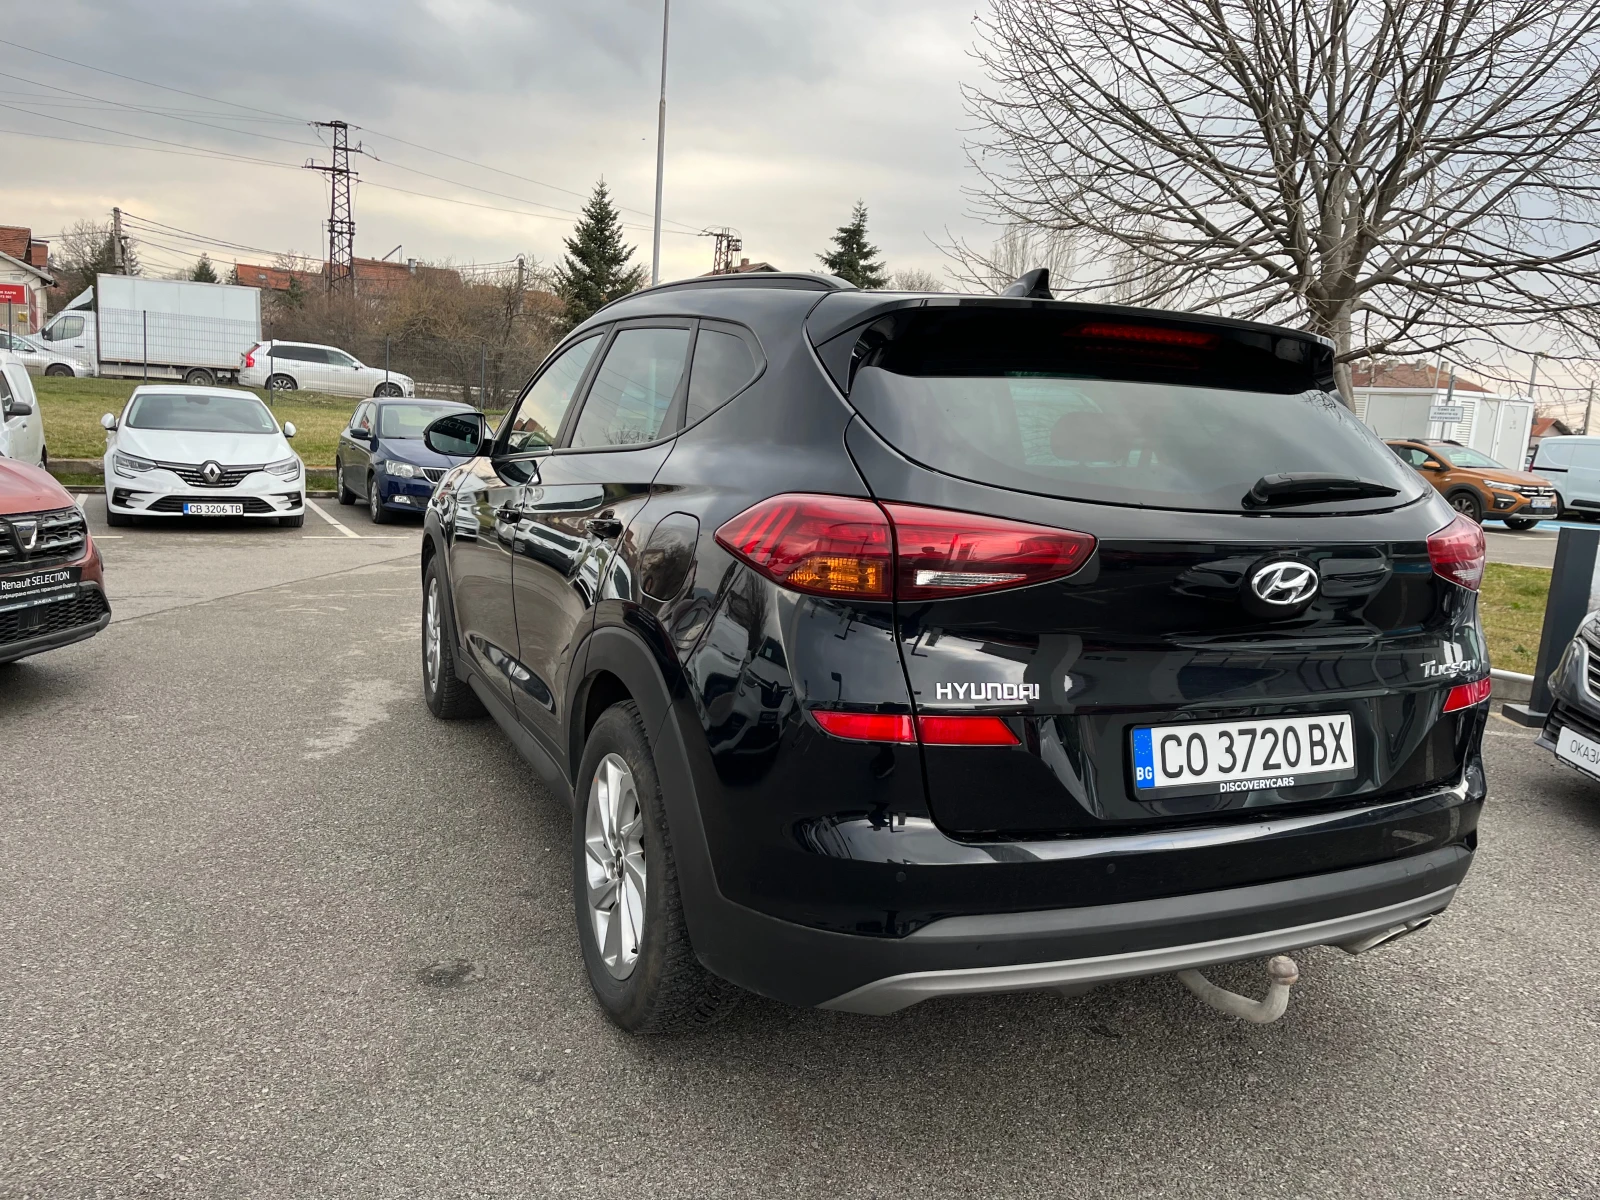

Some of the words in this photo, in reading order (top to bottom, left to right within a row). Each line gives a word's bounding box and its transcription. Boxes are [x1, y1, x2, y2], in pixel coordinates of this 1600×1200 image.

[190, 504, 203, 514] CB
[204, 504, 228, 514] 3206
[229, 504, 242, 514] TB
[1, 577, 31, 590] Renault
[31, 571, 70, 586] SELECTION
[936, 682, 1040, 700] HYUNDAI
[1160, 732, 1209, 778] CO
[1218, 725, 1301, 774] 3720
[1308, 721, 1348, 766] BX
[1136, 766, 1153, 780] BG
[1219, 777, 1295, 792] DISCOVERYCARS
